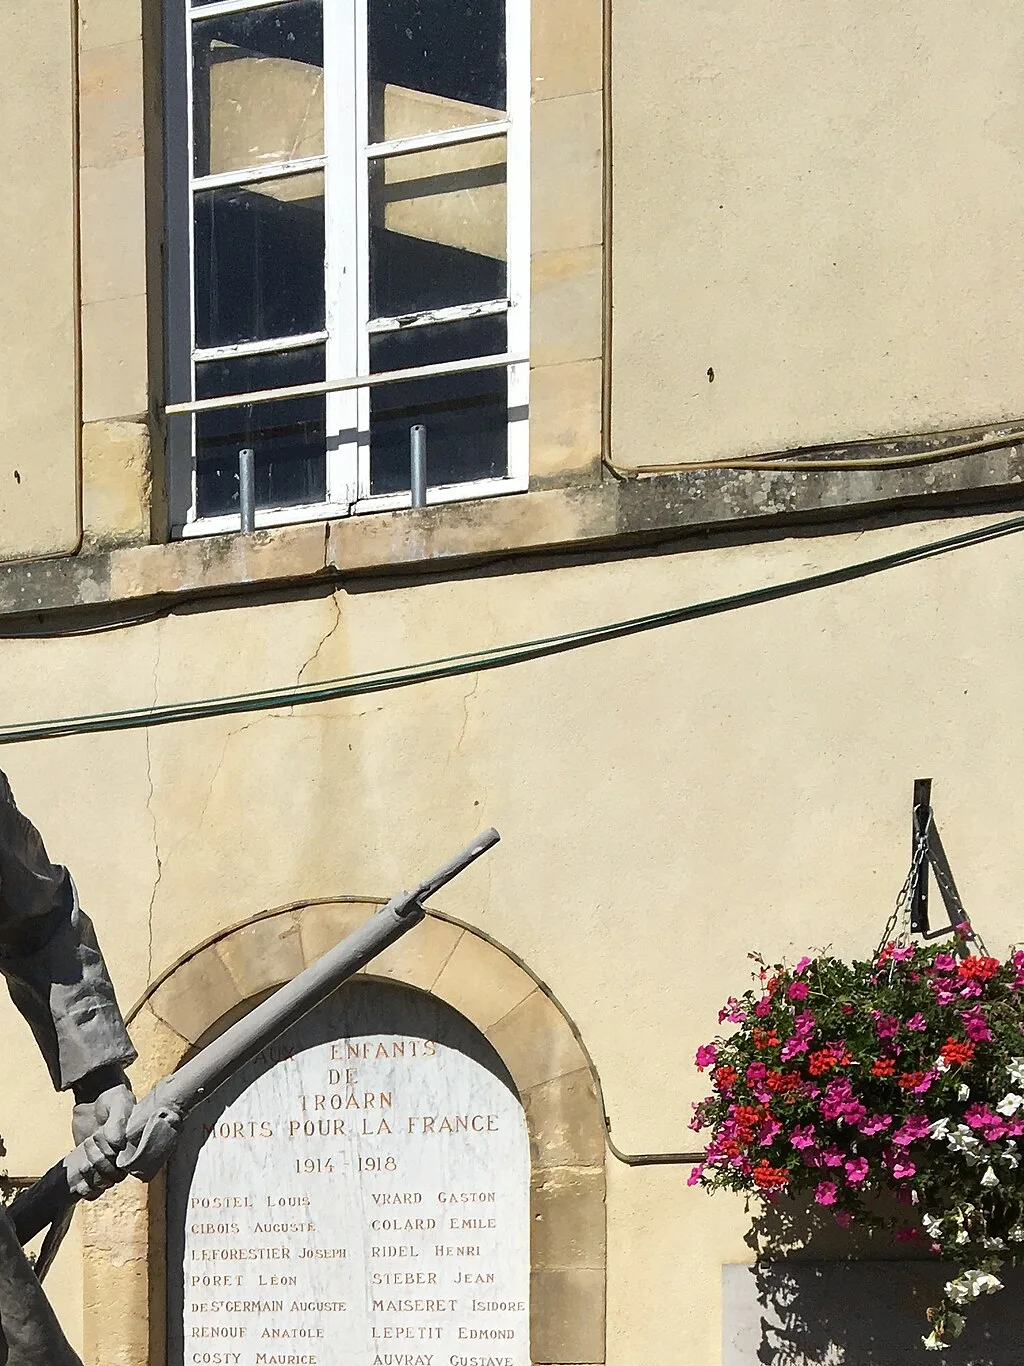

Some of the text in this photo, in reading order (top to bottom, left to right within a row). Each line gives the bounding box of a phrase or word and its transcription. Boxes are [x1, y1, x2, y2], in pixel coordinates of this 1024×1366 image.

[330, 1039, 437, 1062] ENFANTS
[328, 1068, 359, 1086] DE
[298, 1091, 393, 1112] TROARN
[202, 1115, 500, 1139] MORTS POUR LA FRANCE
[295, 1157, 335, 1174] 1914
[357, 1155, 398, 1172] 1918
[191, 1195, 311, 1209] POSTEL LOUIS
[371, 1191, 496, 1205] VRARD GASTON
[191, 1222, 316, 1234] CIBOIS AUGUSTE
[371, 1218, 497, 1231] COLARD EMILE
[191, 1247, 346, 1261] LEFORESTIER JOSEPH
[371, 1245, 481, 1257] RIDEL HENRI
[191, 1273, 297, 1287] PORET LÉON
[372, 1272, 495, 1285] STEBER JEAN
[191, 1303, 208, 1312] DE
[290, 1300, 347, 1312] AUGUSTE
[372, 1299, 525, 1312] MAISERET ISIDORE
[191, 1326, 324, 1338] RENOUF ANATOLE
[371, 1327, 515, 1340] LEPETIT EDMOND
[192, 1352, 317, 1365] COSTY MAURICE
[373, 1354, 514, 1366] AUVRAY GUSTAVE
